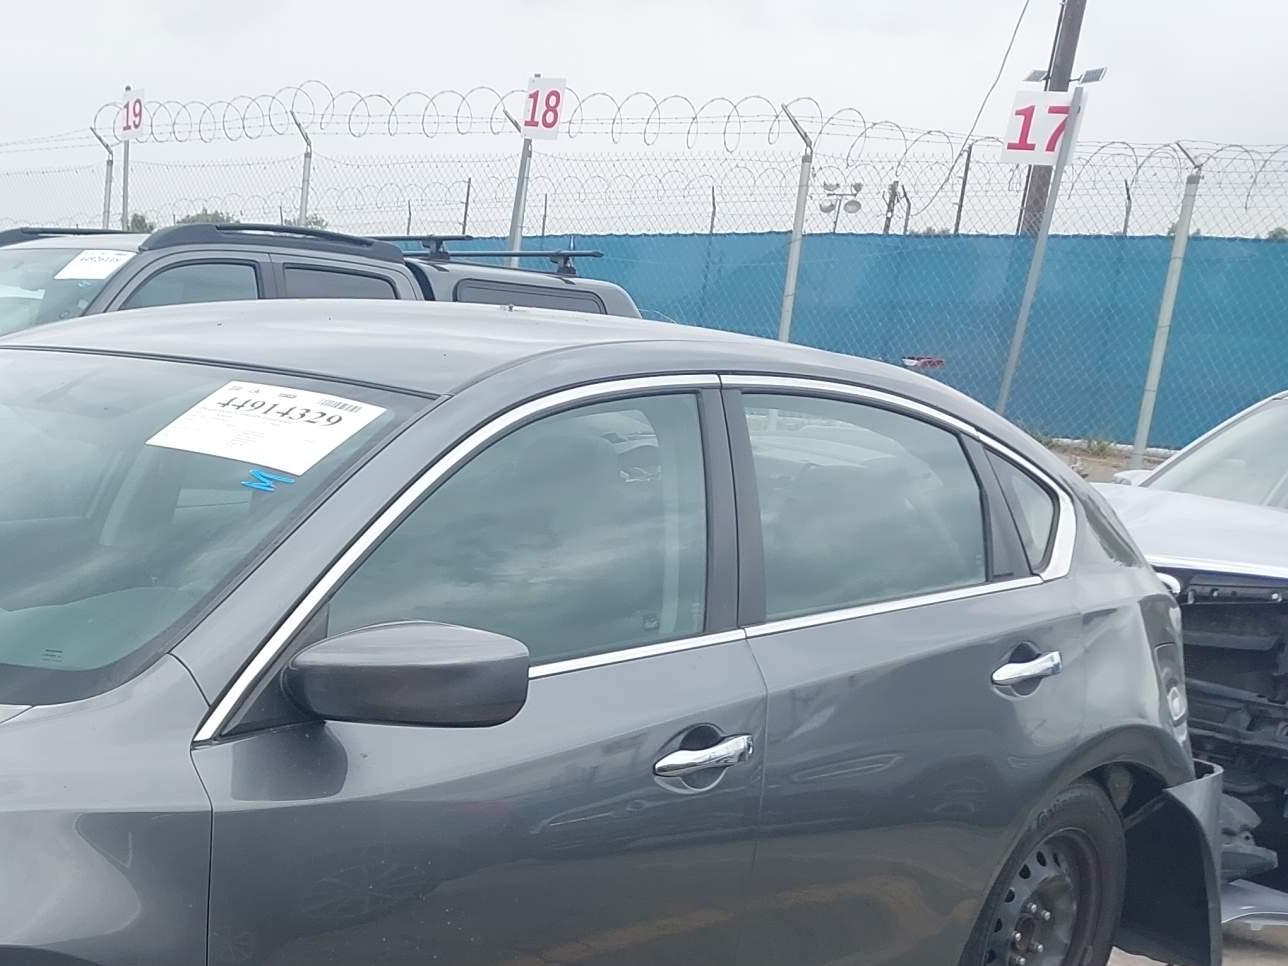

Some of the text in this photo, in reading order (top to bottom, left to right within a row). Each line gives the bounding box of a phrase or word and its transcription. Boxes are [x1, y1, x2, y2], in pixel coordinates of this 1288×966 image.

[122, 98, 143, 131] 19
[523, 89, 561, 129] 18
[1006, 104, 1072, 153] 17
[216, 396, 343, 426] 44914329
